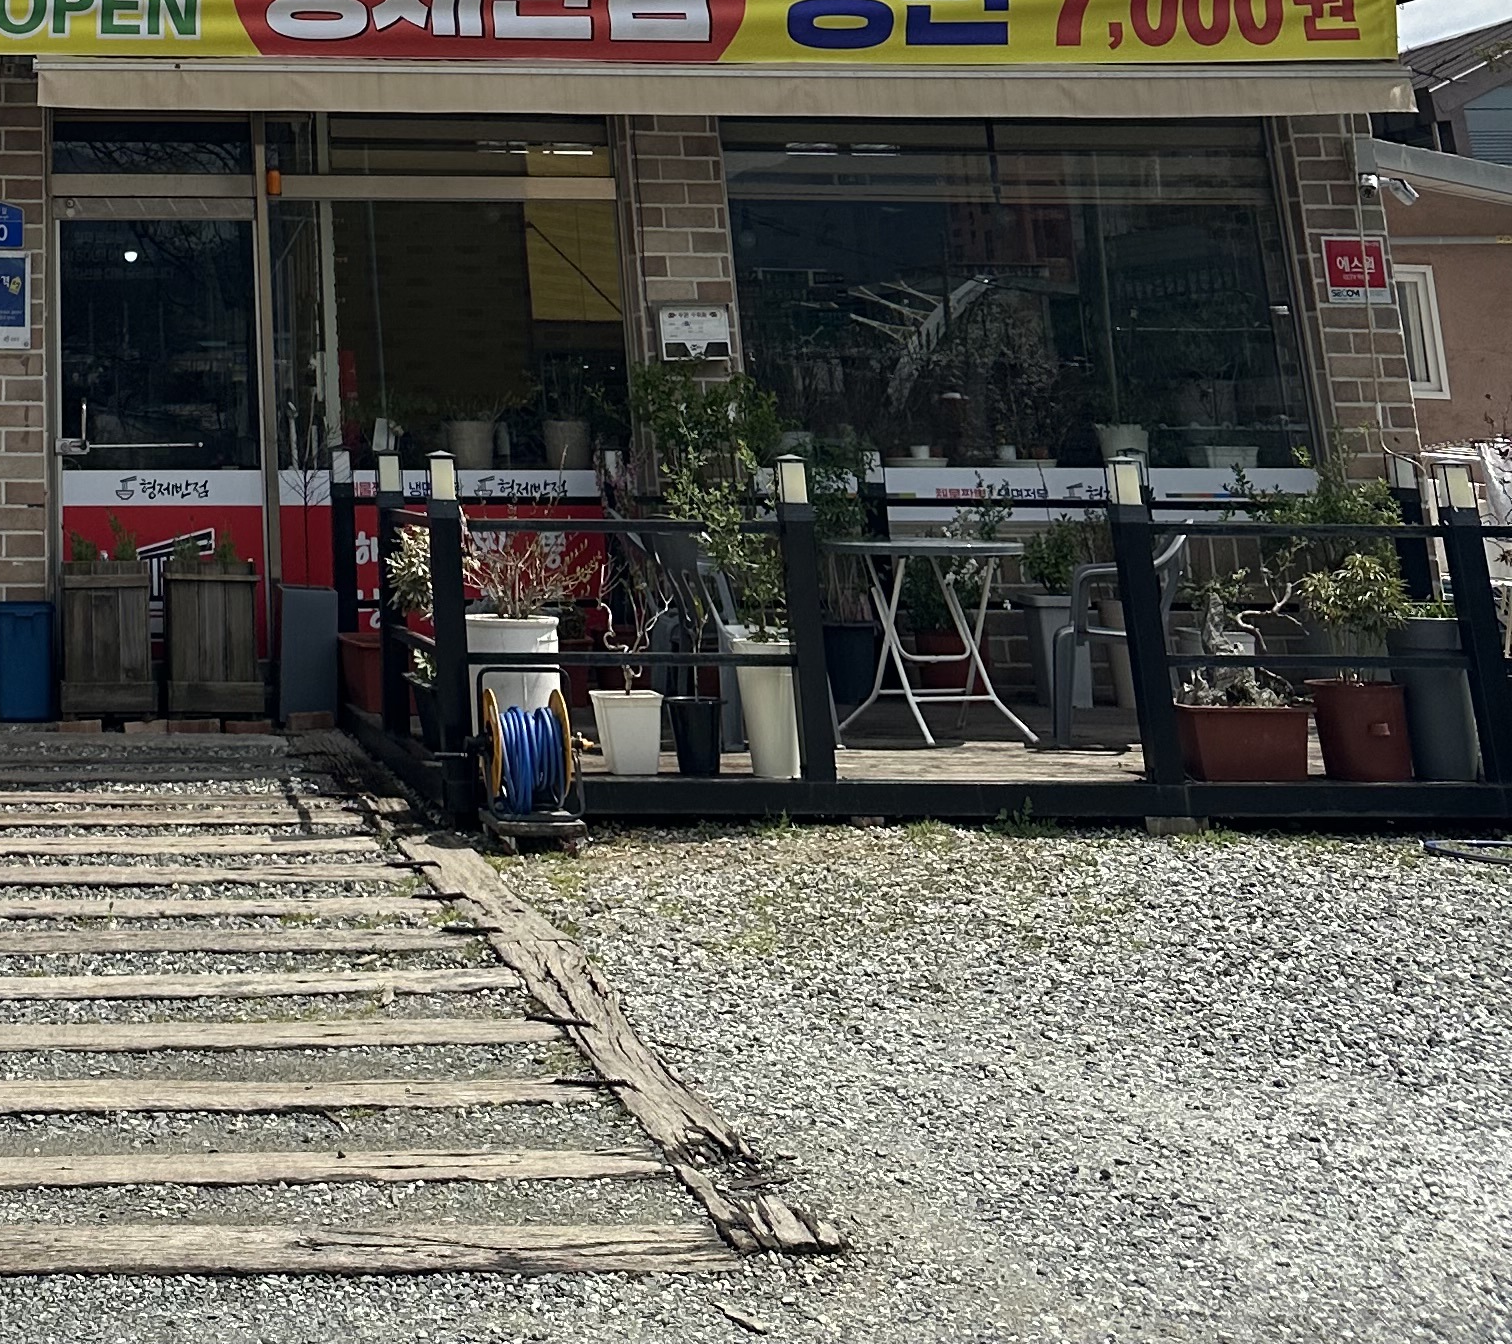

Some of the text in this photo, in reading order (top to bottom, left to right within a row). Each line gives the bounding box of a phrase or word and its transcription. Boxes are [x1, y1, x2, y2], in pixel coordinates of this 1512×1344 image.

[1335, 255, 1376, 273] 에스원
[139, 479, 210, 499] 형제반점
[497, 478, 568, 498] 형제반점
